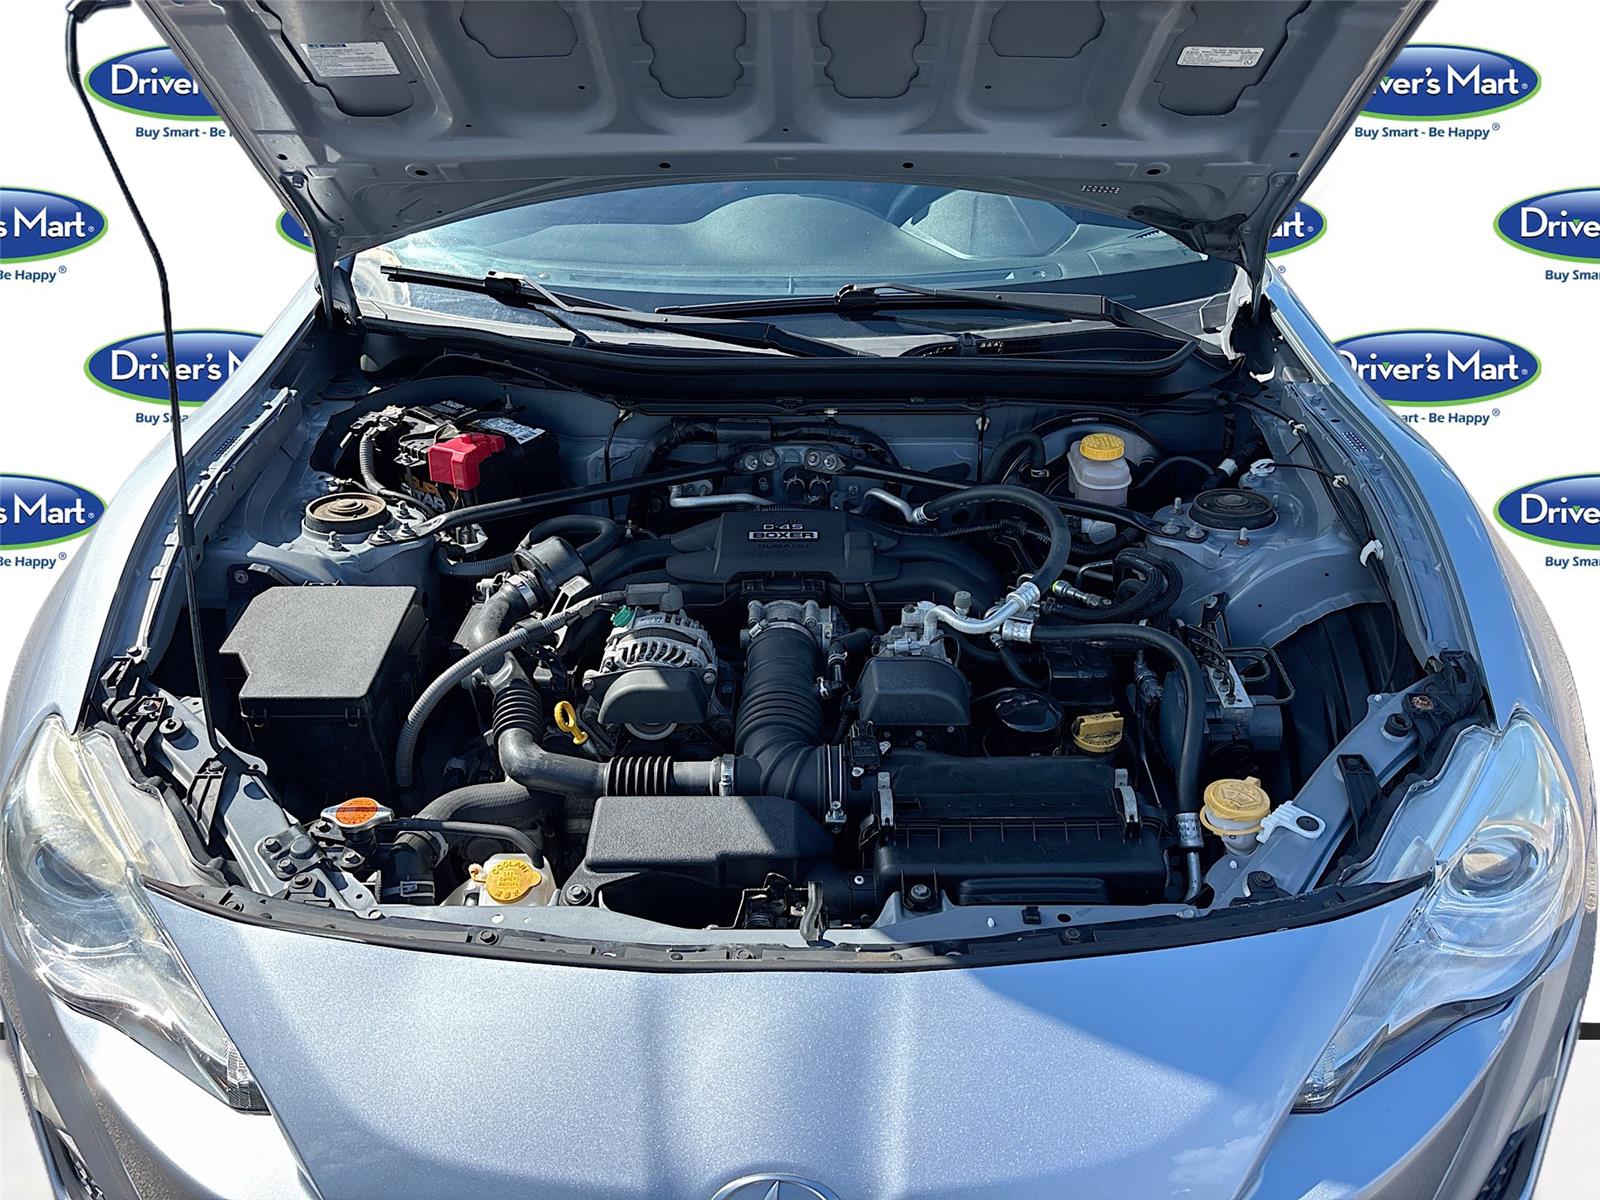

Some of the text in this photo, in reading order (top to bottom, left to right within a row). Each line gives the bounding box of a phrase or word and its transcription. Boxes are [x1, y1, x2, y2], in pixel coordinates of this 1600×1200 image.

[111, 63, 199, 95] Driver
[1447, 63, 1520, 95] Mart
[135, 127, 160, 140] Buy
[162, 127, 200, 138] Smart
[209, 127, 226, 138] Be
[1354, 127, 1379, 140] Buy
[1382, 127, 1419, 138] Smart
[1428, 127, 1445, 138] Be
[1448, 127, 1490, 140] Happy
[13, 206, 87, 238] Mart
[1520, 206, 1600, 238] Drive
[15, 269, 57, 283] Happy
[1545, 269, 1600, 283] Buy Sma
[1447, 349, 1520, 381] Mart
[135, 413, 160, 425] Buy
[1428, 413, 1445, 424] Be
[1448, 413, 1490, 426] Happy
[13, 492, 87, 524] Mart
[1520, 493, 1600, 524] Drive
[752, 532, 816, 540] BOXER
[15, 556, 57, 570] Happy
[1545, 556, 1600, 570] Buy Sma
[492, 860, 530, 876] COOLANT
